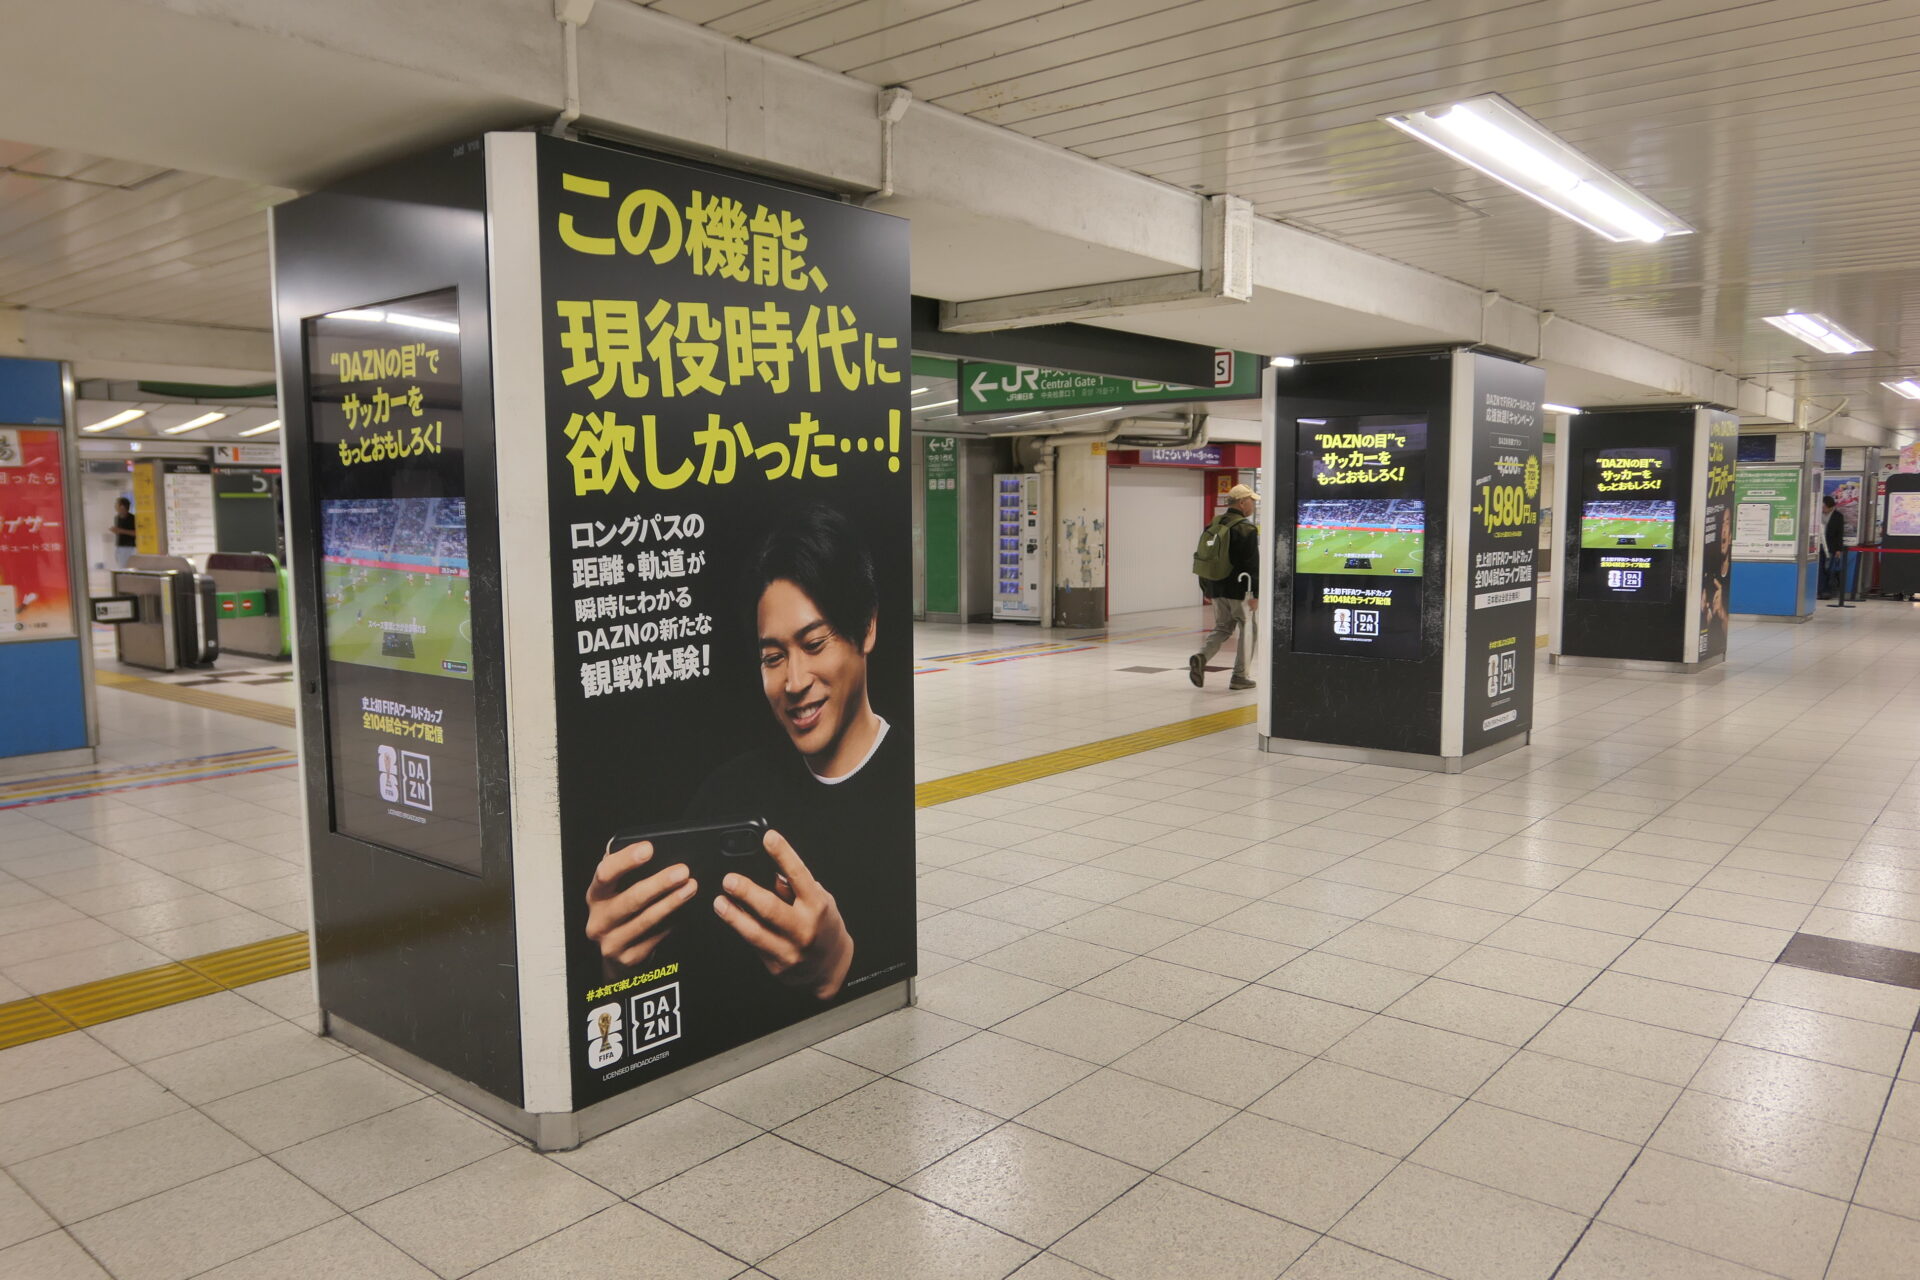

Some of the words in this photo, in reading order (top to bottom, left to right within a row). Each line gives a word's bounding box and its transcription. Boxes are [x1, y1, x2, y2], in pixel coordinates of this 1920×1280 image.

[558, 172, 828, 293] この機能、
[557, 299, 901, 400] 現役時代に
[1002, 366, 1039, 392] JR
[1041, 377, 1072, 390] Central
[1075, 376, 1096, 387] Gate
[1099, 376, 1104, 385] 1
[342, 386, 424, 430] サッカーを
[339, 421, 442, 467] もっとおもしろく!
[563, 409, 901, 496] 欲しかった…!
[1322, 450, 1392, 470] サッカーを
[1317, 466, 1405, 486] もっとおもしろく!
[1597, 480, 1662, 492] もっとおもしろく!
[1601, 469, 1652, 481] サッカーを
[570, 513, 705, 549] ロングパスの
[572, 548, 706, 588] 距離・軌道が
[575, 587, 692, 622] 瞬時にわかる
[577, 613, 712, 654] DAZNの新たな
[580, 644, 710, 699] 観戦体験!
[362, 711, 444, 744] 全104試合ライブ配信
[598, 1051, 614, 1062] FIFA
[603, 1064, 630, 1081] LICENSED
[630, 1050, 670, 1071] BROADCASTER
